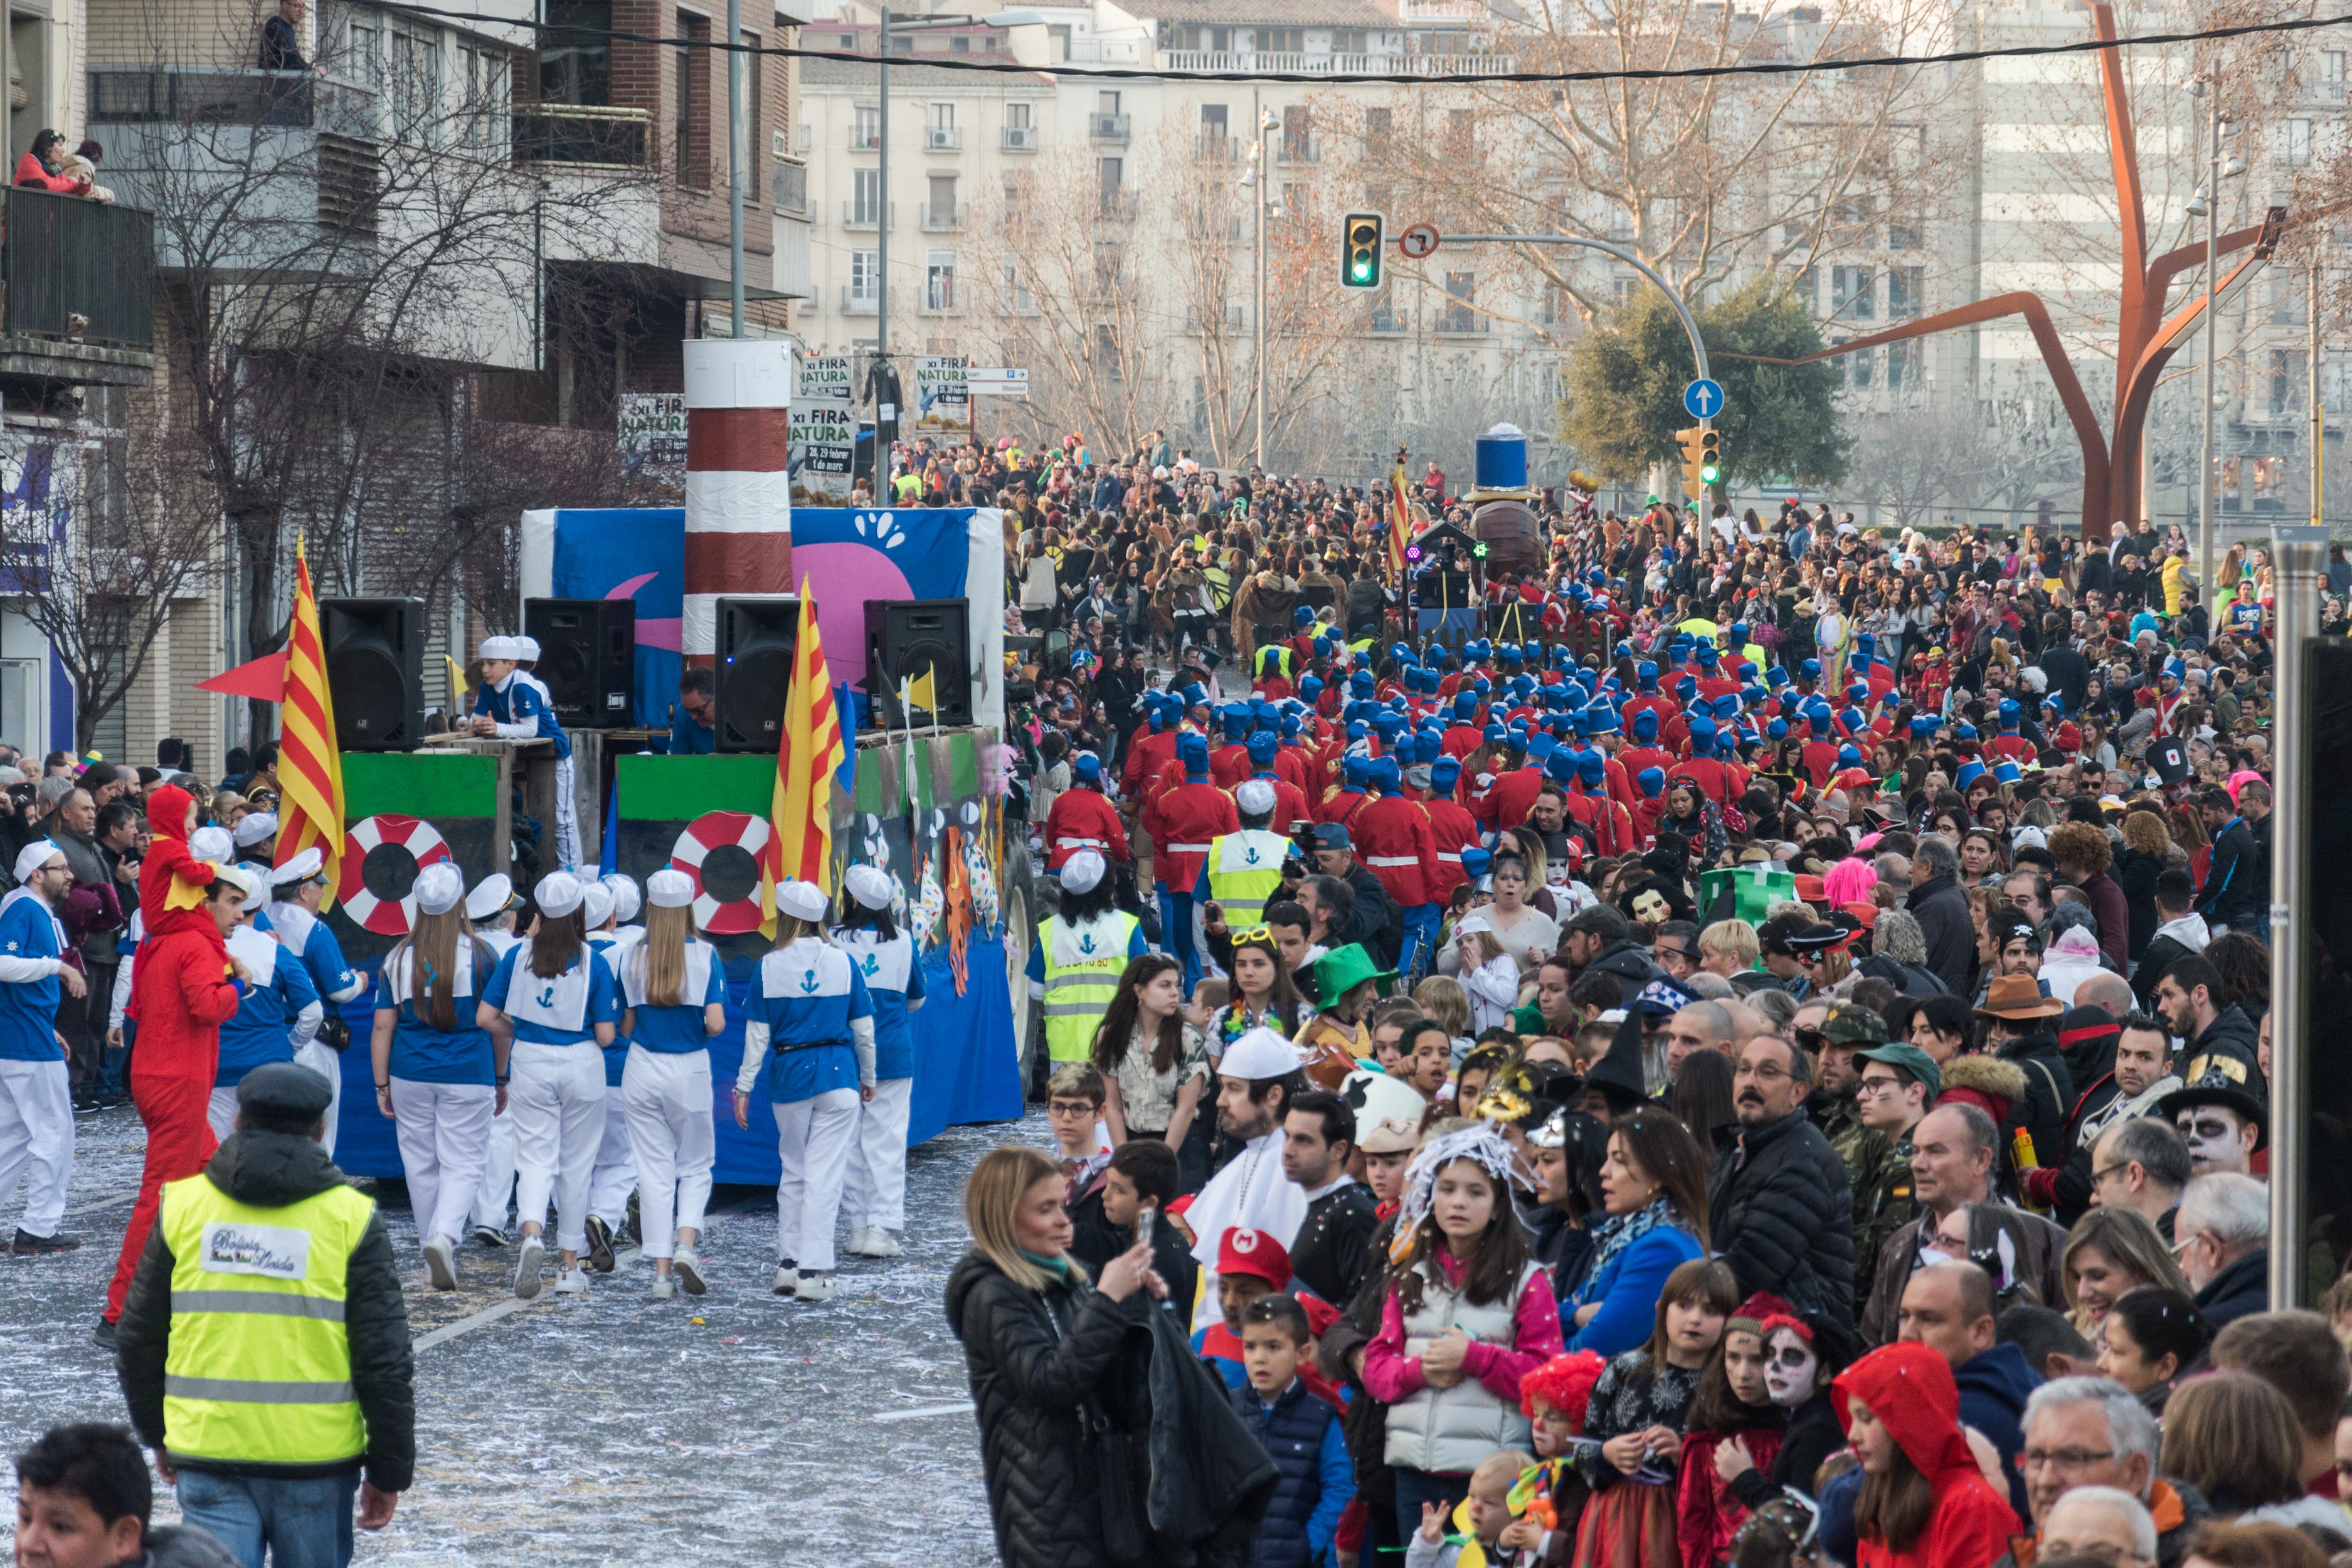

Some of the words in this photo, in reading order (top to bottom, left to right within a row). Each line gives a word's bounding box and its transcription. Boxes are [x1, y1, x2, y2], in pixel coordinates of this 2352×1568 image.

[819, 359, 847, 369] FIRA
[941, 357, 968, 369] FIRA
[917, 370, 968, 381] NATURA
[656, 398, 682, 415] FIR
[793, 413, 805, 423] XI
[812, 409, 850, 425] FIRA
[809, 446, 818, 459] 28,
[820, 447, 828, 458] 29
[829, 448, 849, 460] febrer
[812, 458, 816, 469] 1
[817, 459, 825, 470] de
[827, 462, 844, 472] març
[1236, 1233, 1253, 1247] M
